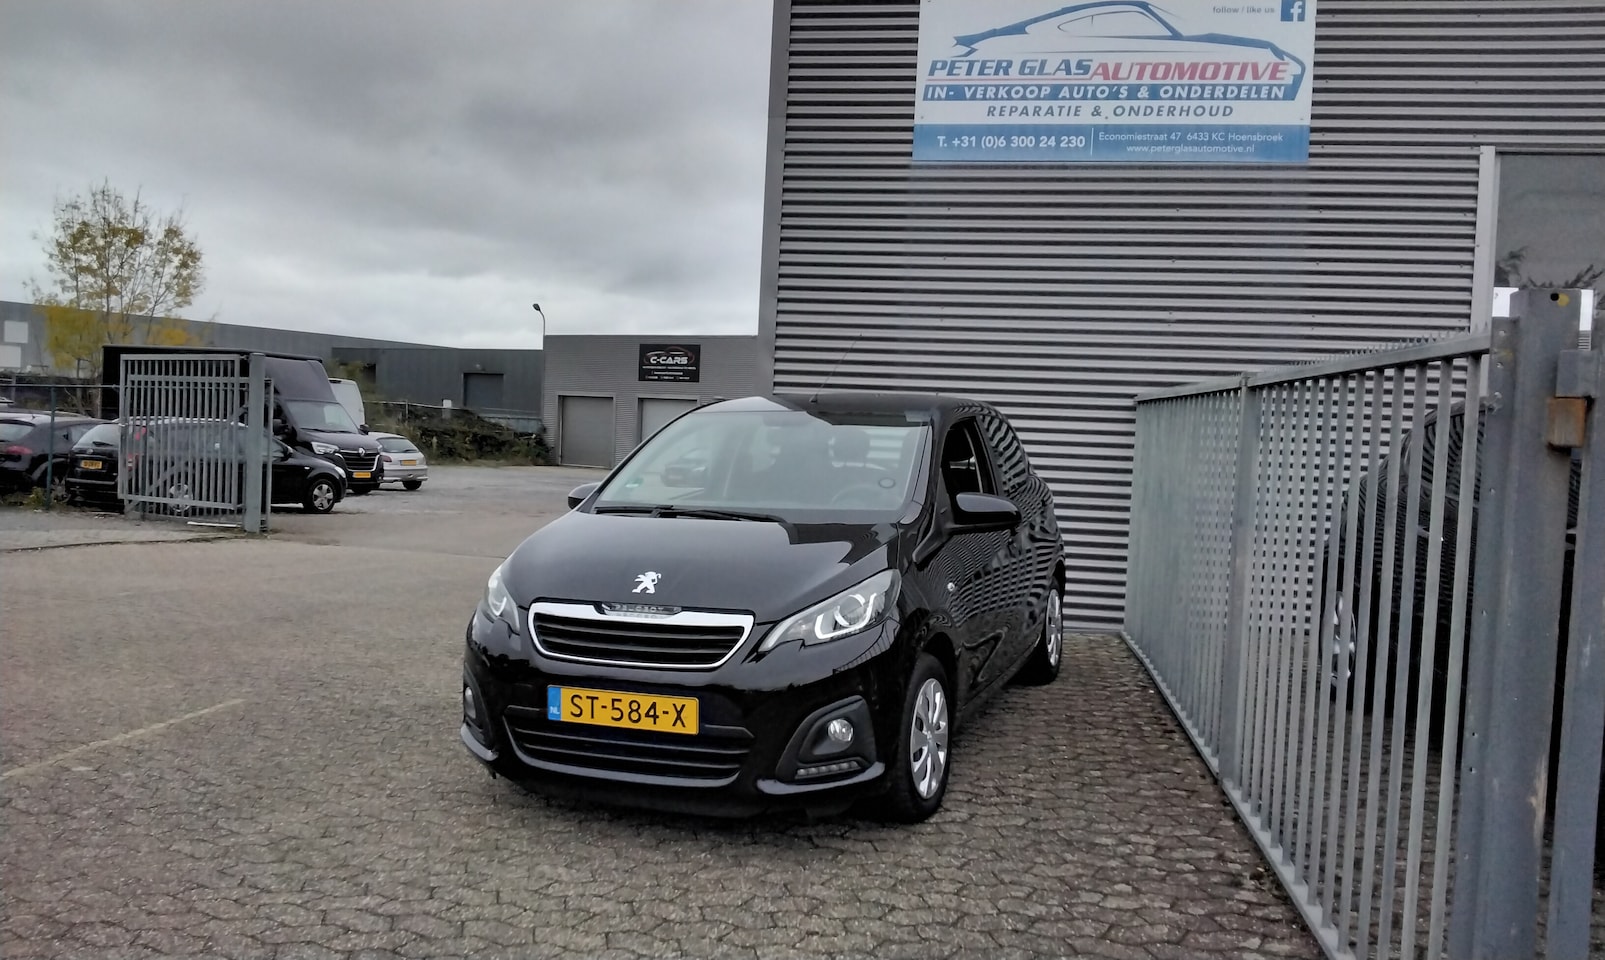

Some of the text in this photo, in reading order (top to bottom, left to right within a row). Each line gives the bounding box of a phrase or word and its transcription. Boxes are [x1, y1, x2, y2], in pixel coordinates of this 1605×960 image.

[1213, 6, 1239, 14] follow
[1247, 6, 1262, 14] like
[928, 59, 1013, 76] PETER
[927, 85, 1285, 99] IN- VERKOOP AUTO'S & ONDERDELEN
[986, 105, 1234, 118] REPARATIE & ONDERHOUD
[937, 135, 1086, 149] T. +31 (0)6 300 24 230
[1098, 131, 1284, 142] Economiestraat 47 6433 KC Hoensbroek
[1126, 143, 1255, 154] www.peterglasautomotive.nl
[650, 356, 688, 364] C-CARS
[549, 706, 560, 715] NL
[570, 694, 686, 728] ST-584-X
